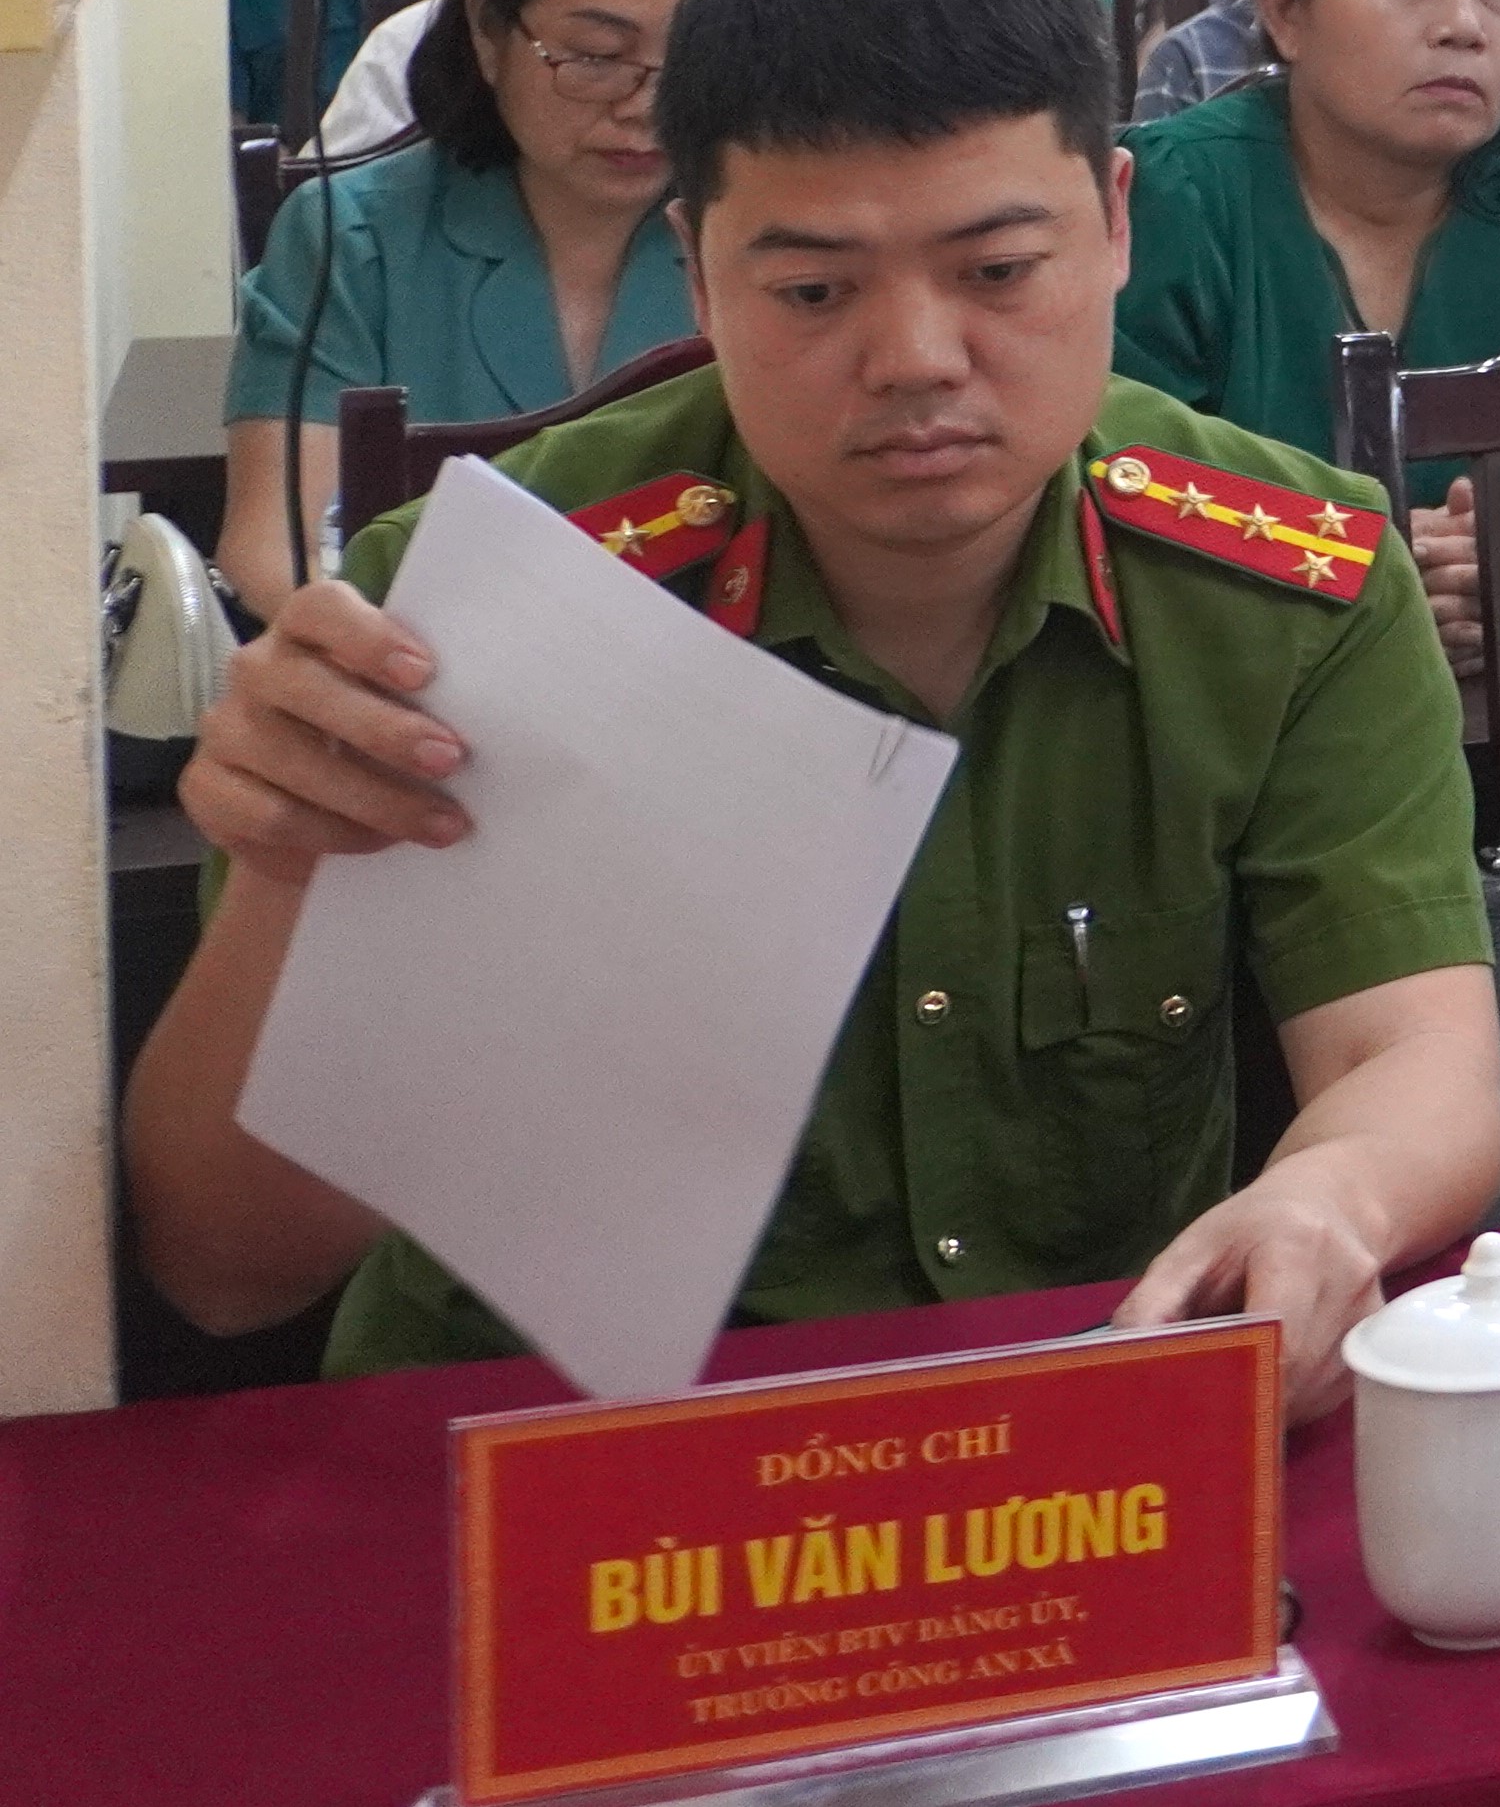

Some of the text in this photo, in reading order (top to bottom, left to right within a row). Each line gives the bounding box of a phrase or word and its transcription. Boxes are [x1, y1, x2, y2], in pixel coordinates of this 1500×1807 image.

[756, 1414, 1011, 1487] ĐỒNG CHÍ
[589, 1483, 1169, 1634] BÙI VĂN LƯƠNG
[738, 1631, 829, 1669] VIÊN
[837, 1621, 911, 1655] BTV
[918, 1604, 1020, 1642] ĐẢNG
[688, 1636, 1076, 1724] TRƯỞNG CÔNG AN XÃ
